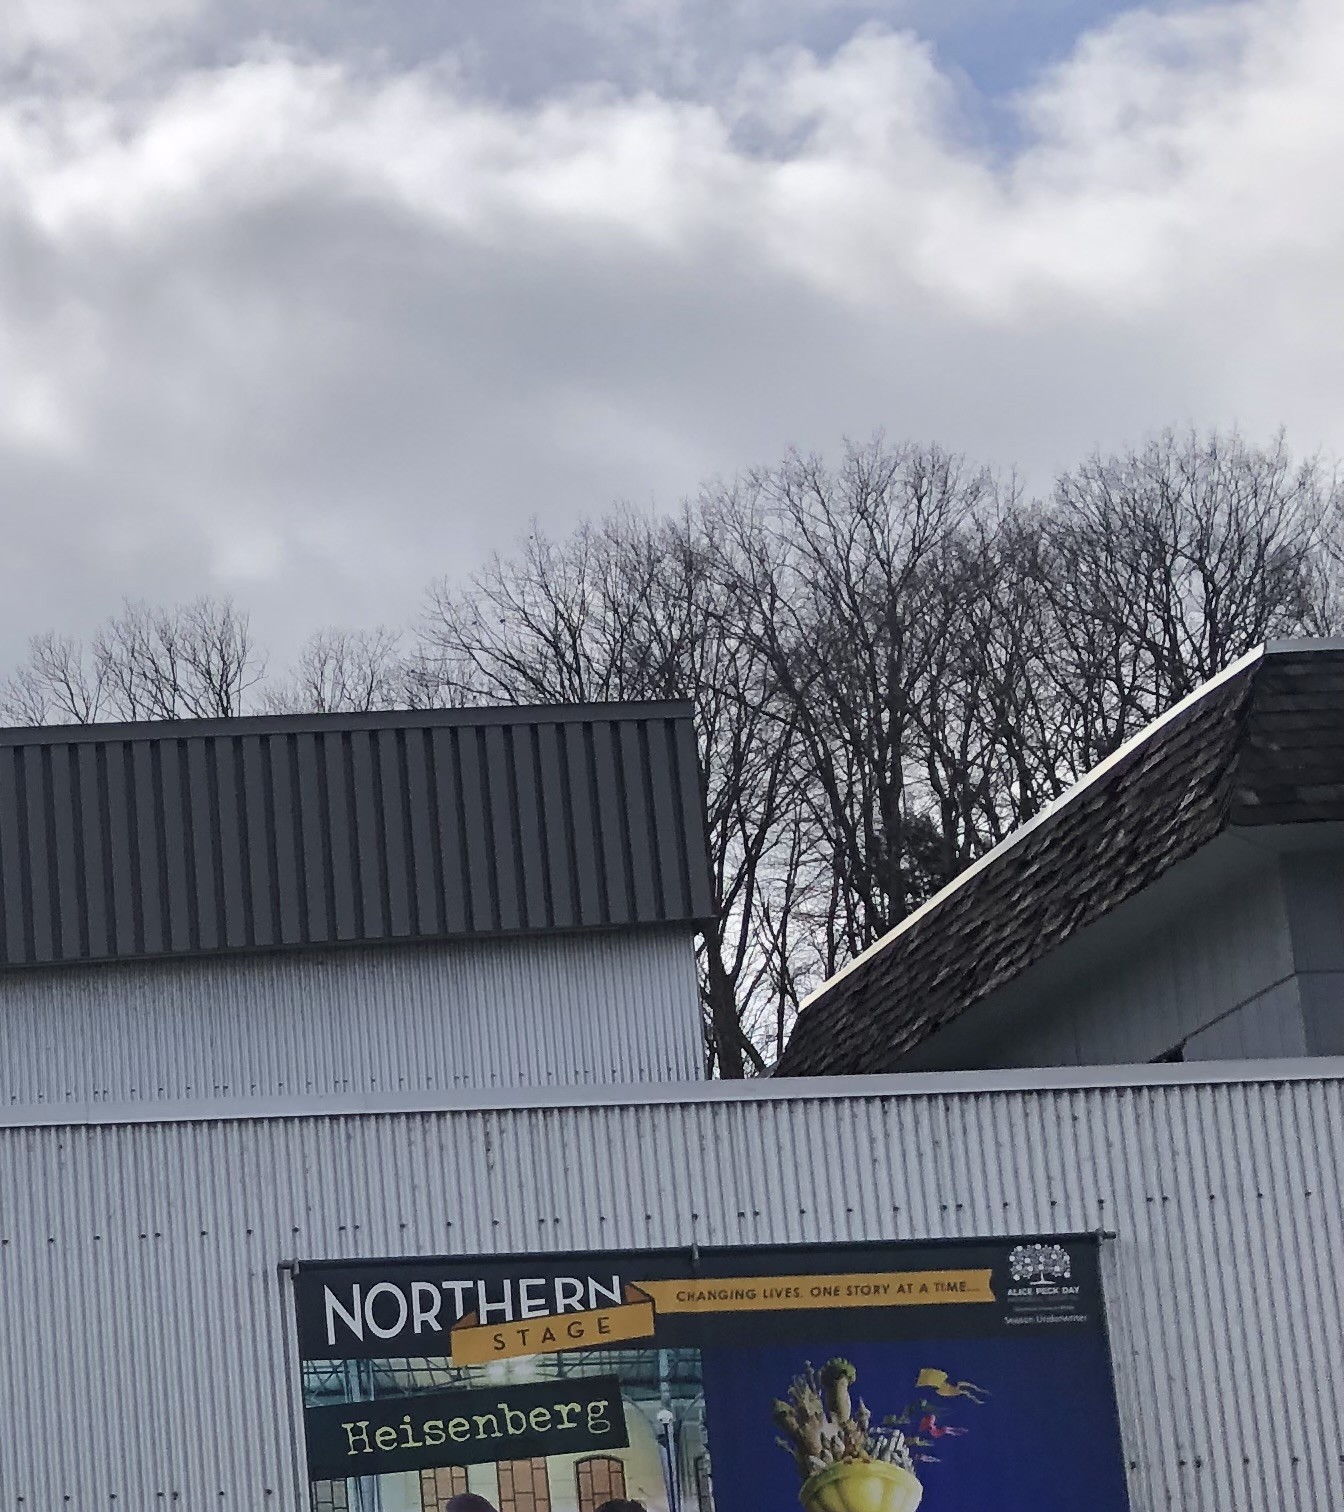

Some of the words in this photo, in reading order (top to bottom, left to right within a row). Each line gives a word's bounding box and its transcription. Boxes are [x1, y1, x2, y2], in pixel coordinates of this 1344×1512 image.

[676, 1289, 757, 1303] CHANGING
[762, 1287, 805, 1300] LIVES.
[809, 1285, 841, 1298] ONE
[846, 1284, 890, 1297] STORY
[897, 1282, 914, 1295] AT
[918, 1282, 929, 1294] A
[1007, 1287, 1032, 1296] ALICE
[1062, 1285, 1080, 1294] DAY
[324, 1275, 622, 1346] NORTHERN
[493, 1316, 612, 1351] STAGE
[341, 1400, 611, 1455] Heisenberg
